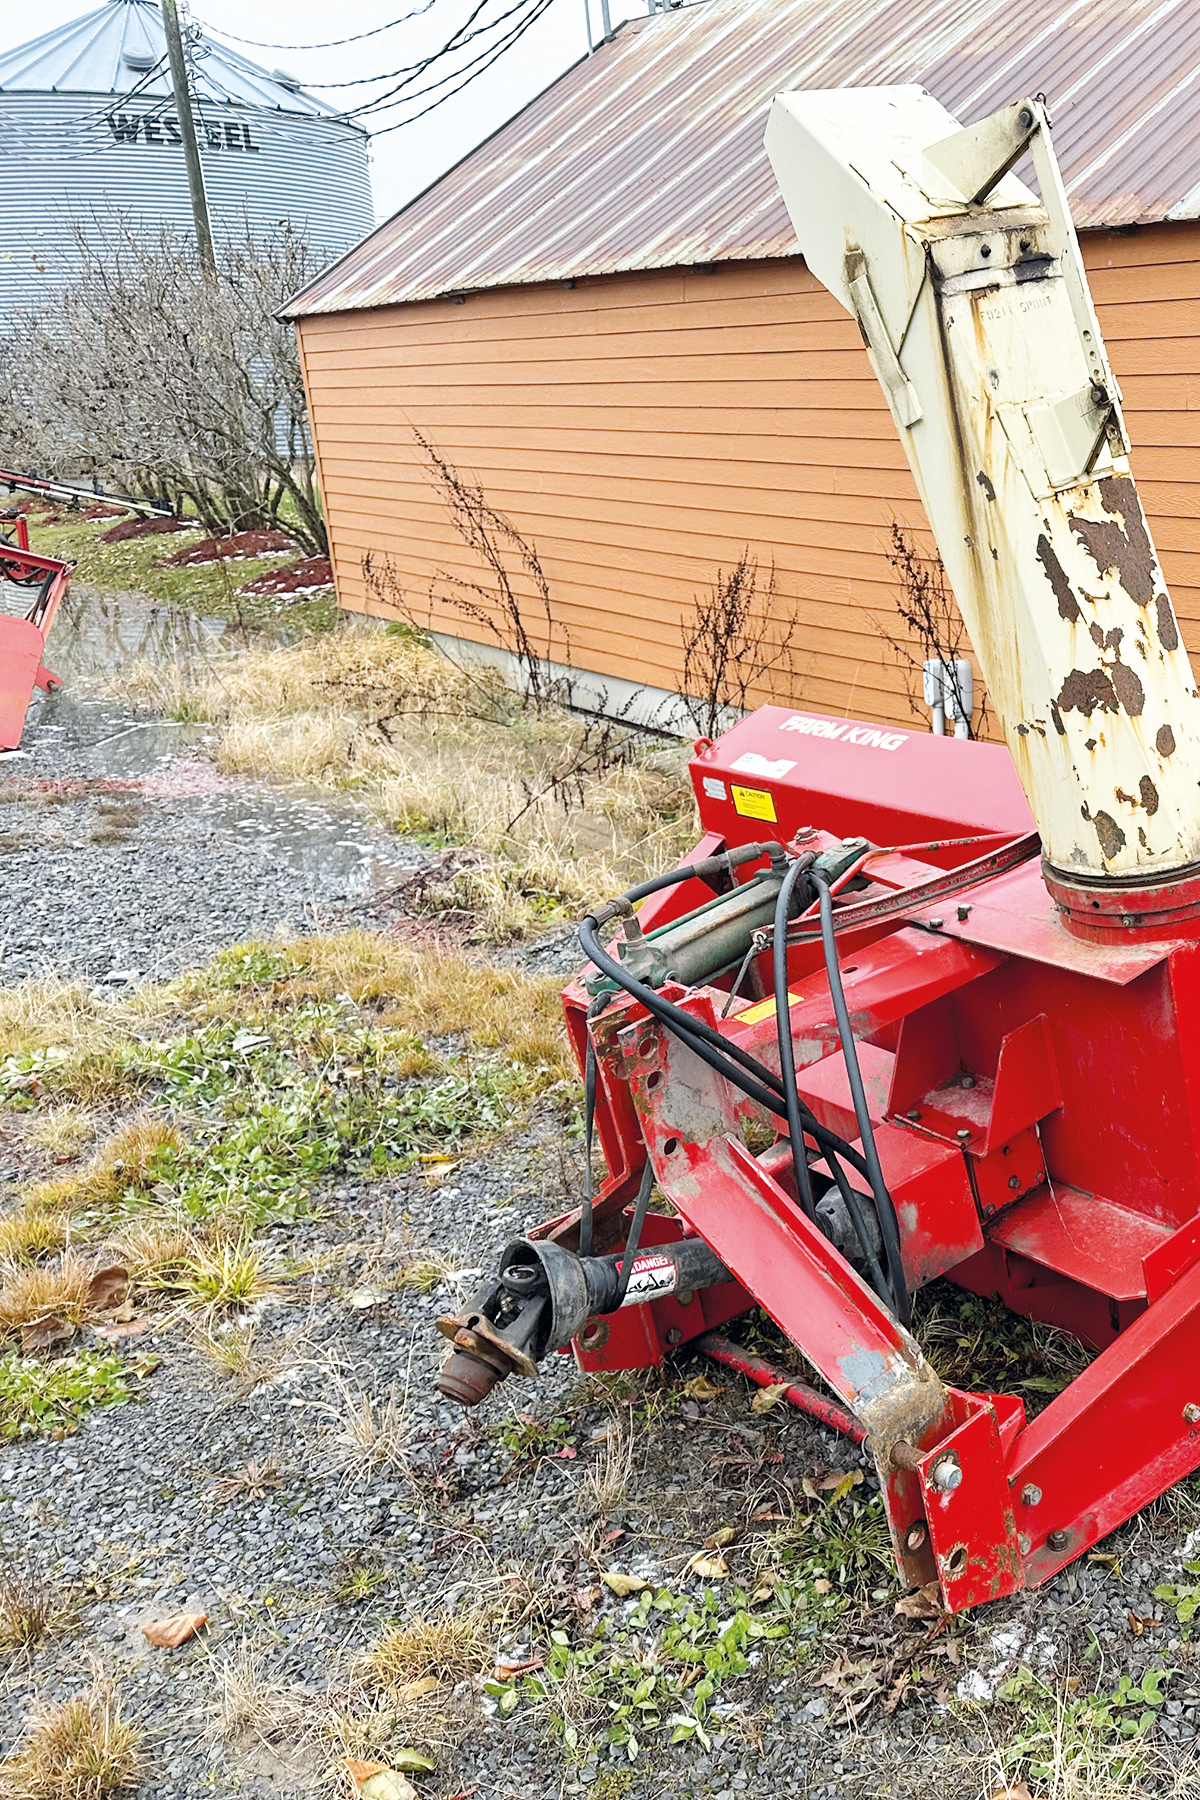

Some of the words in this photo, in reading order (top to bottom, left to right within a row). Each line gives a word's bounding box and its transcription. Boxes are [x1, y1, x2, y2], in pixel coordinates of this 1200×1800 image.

[104, 113, 260, 153] WESEEL
[779, 715, 849, 740] FARM
[841, 726, 910, 751] KING
